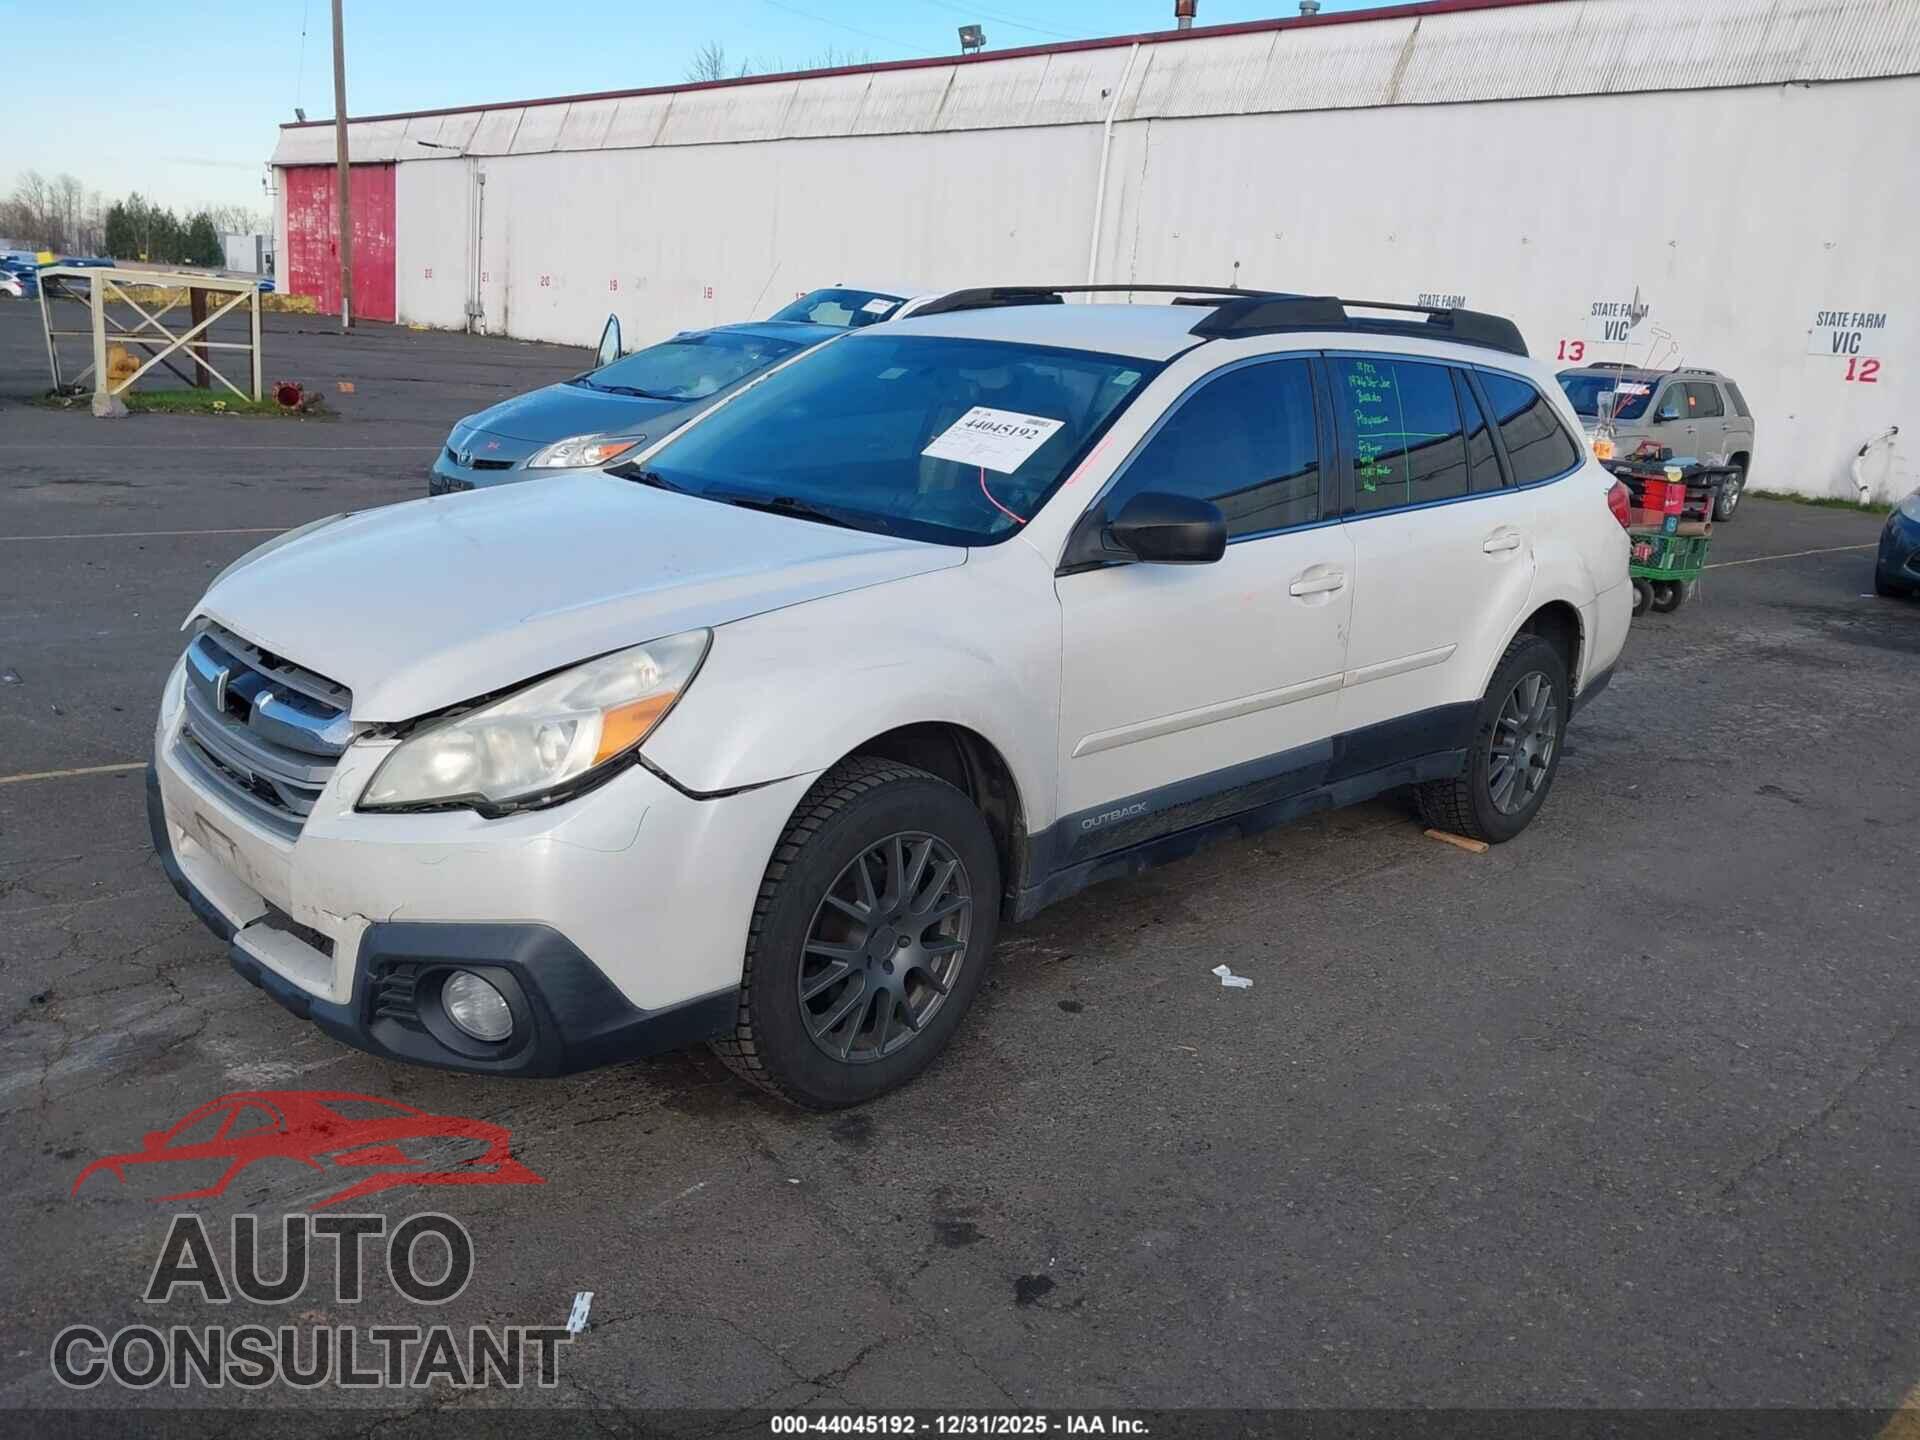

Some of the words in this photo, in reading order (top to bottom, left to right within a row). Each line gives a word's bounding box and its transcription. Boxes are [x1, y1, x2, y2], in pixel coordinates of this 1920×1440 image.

[608, 279, 618, 291] 19
[1417, 293, 1440, 307] STATE
[1441, 294, 1466, 308] FARM
[1592, 302, 1619, 317] STATE
[1620, 303, 1649, 319] FAM
[1604, 320, 1629, 341] VIC
[1816, 311, 1849, 327] STATE
[1850, 312, 1887, 329] FARM
[1557, 339, 1585, 362] 13
[1832, 331, 1861, 354] VIC
[1845, 358, 1881, 383] 12
[965, 418, 1039, 439] 44045192
[1081, 801, 1147, 830] OUTBACK
